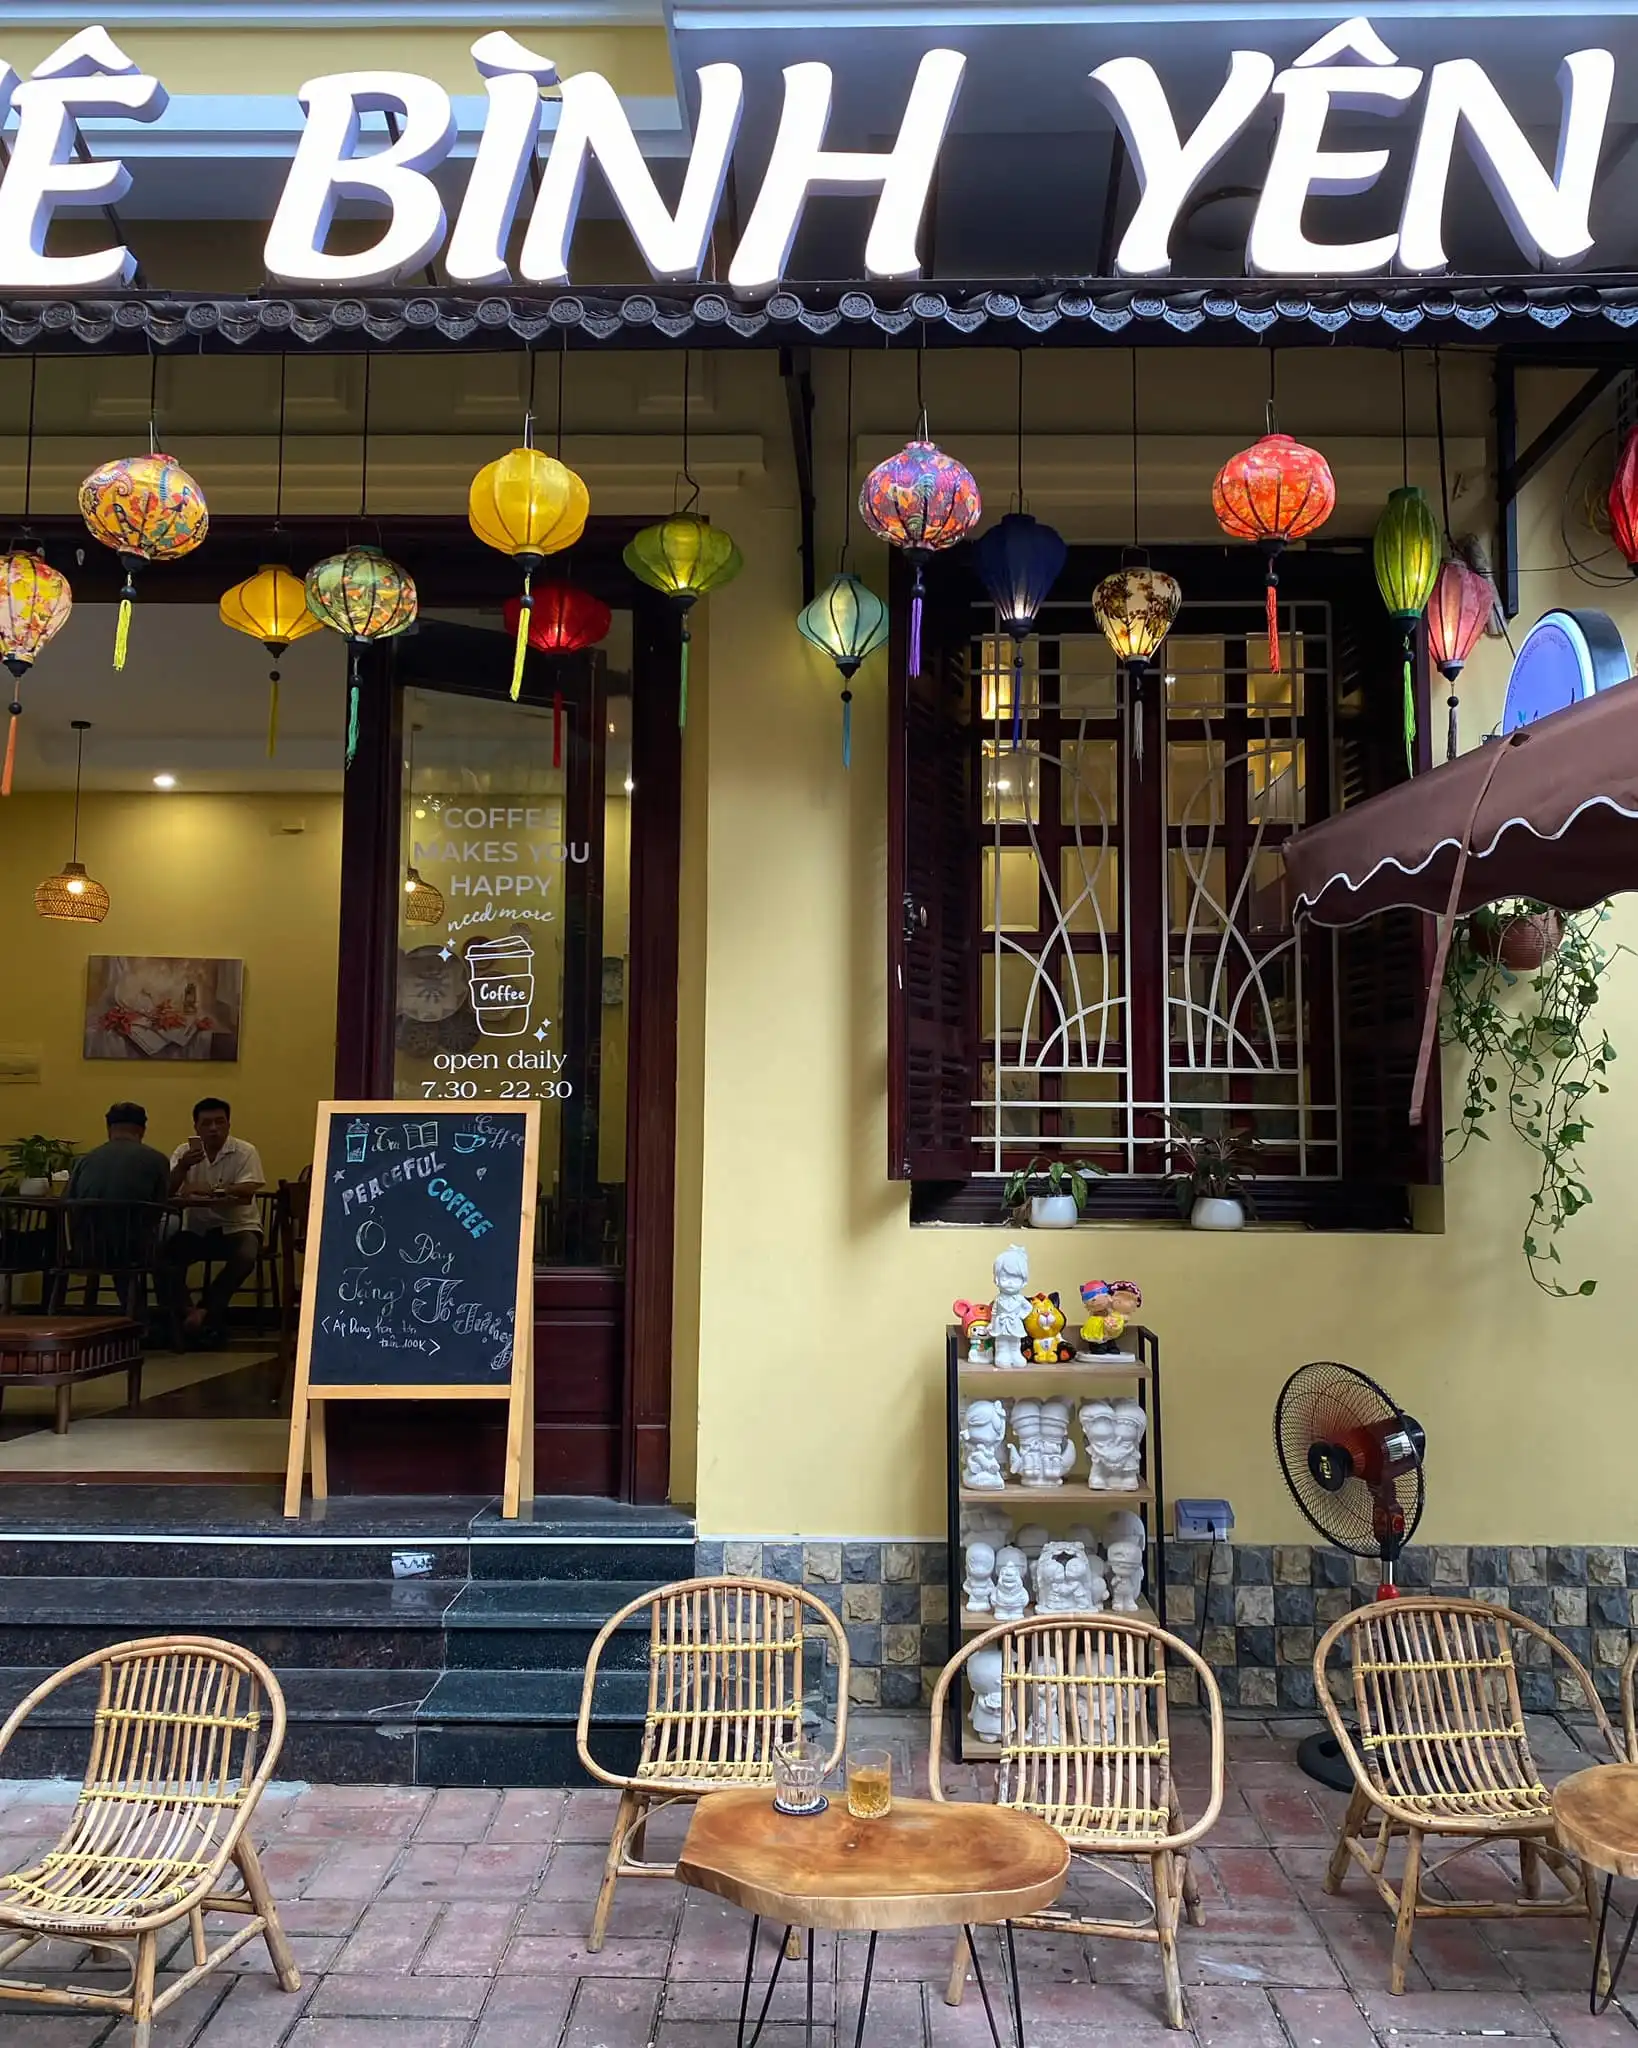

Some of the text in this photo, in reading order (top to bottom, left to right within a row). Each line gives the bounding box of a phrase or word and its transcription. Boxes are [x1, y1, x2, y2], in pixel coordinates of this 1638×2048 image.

[0, 17, 1615, 294] Ê BÌNH YÊN
[443, 807, 561, 830] COFFEE
[413, 841, 590, 864] MAKES YOU
[450, 875, 553, 897] HAPPY
[447, 902, 556, 932] need more
[479, 982, 526, 1001] Coffee
[433, 1050, 567, 1074] open daily
[421, 1081, 478, 1098] 7.30
[499, 1081, 573, 1098] 22.30
[341, 1151, 447, 1216] PEACEFUL
